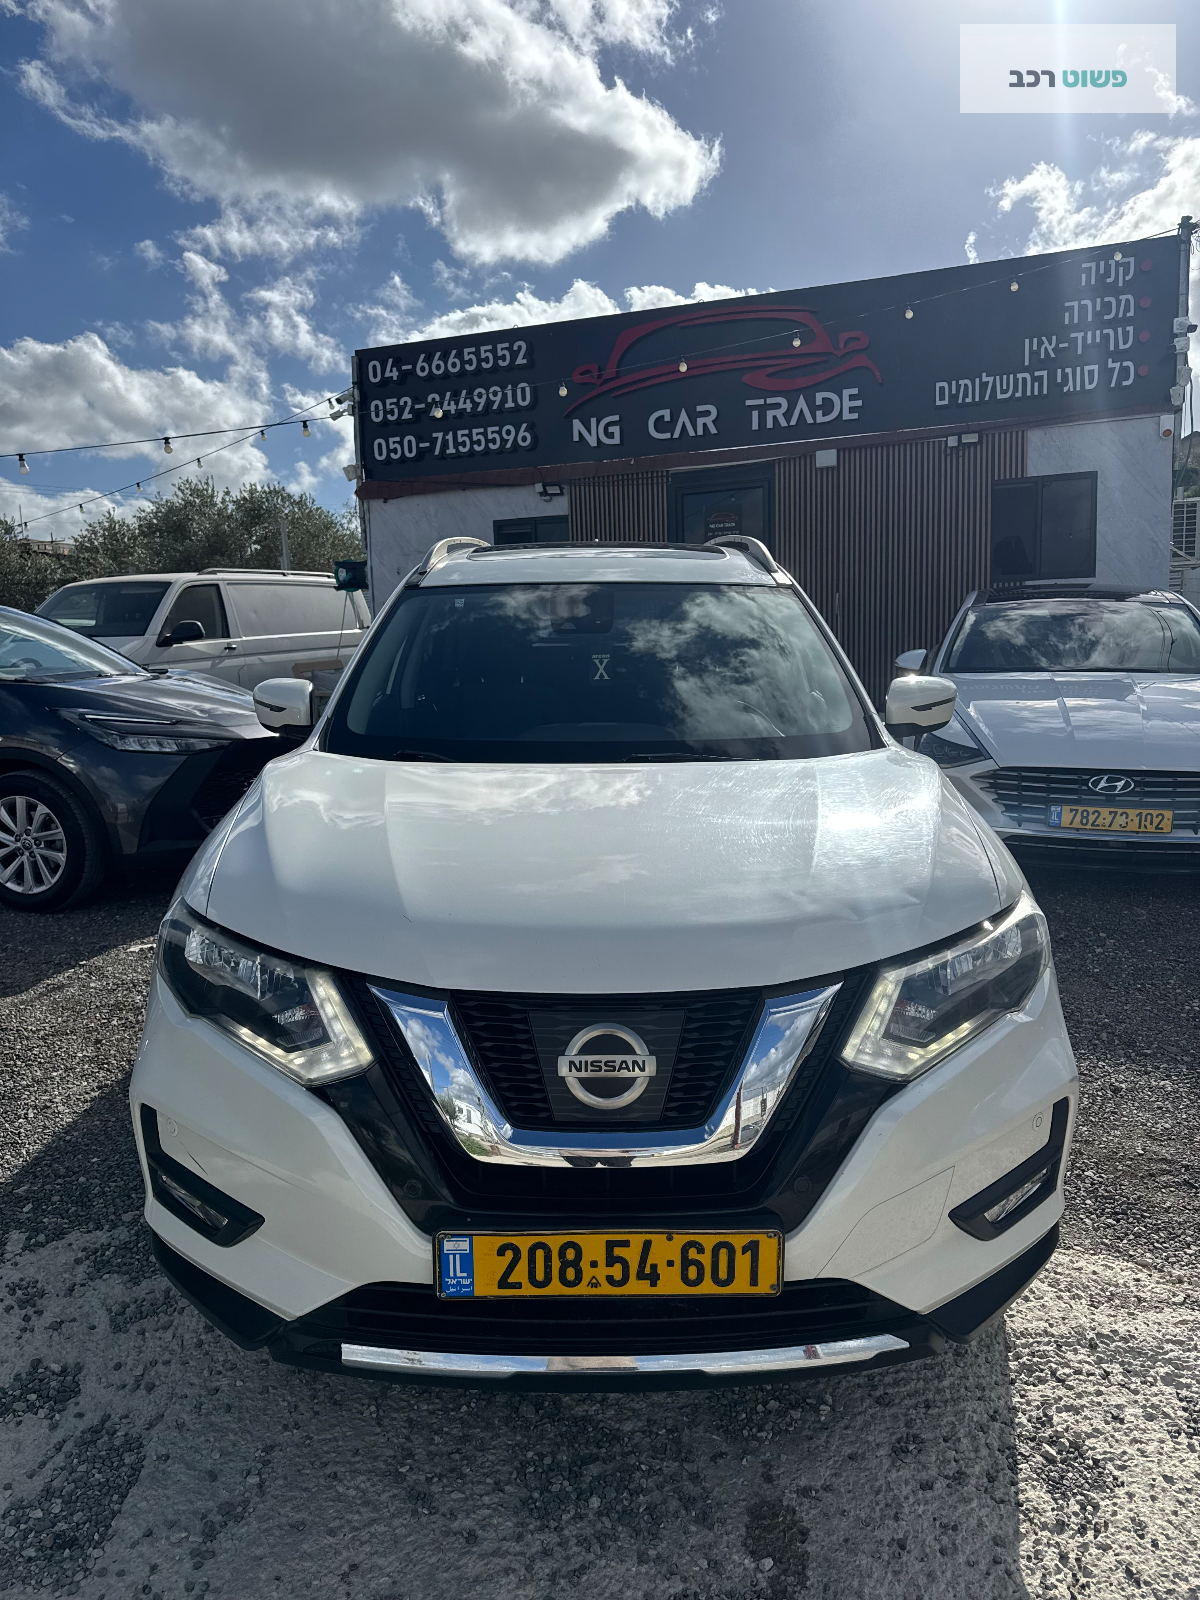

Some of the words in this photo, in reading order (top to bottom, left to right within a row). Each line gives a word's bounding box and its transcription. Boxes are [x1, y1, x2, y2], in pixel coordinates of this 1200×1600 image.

[1080, 256, 1135, 287] קניה
[1064, 294, 1135, 325] מכירה
[1024, 325, 1134, 366] טרייד-אין
[367, 340, 528, 383] 04-6665552
[1107, 358, 1135, 388] כל
[935, 369, 1048, 406] התשלומים
[1056, 364, 1099, 393] סוגי
[572, 414, 621, 447] NG
[648, 404, 718, 440] CAR
[745, 387, 863, 431] TRADE
[373, 422, 532, 461] 050-7155596
[592, 659, 610, 680] X
[567, 1059, 647, 1073] NISSAN
[448, 1253, 468, 1278] IL
